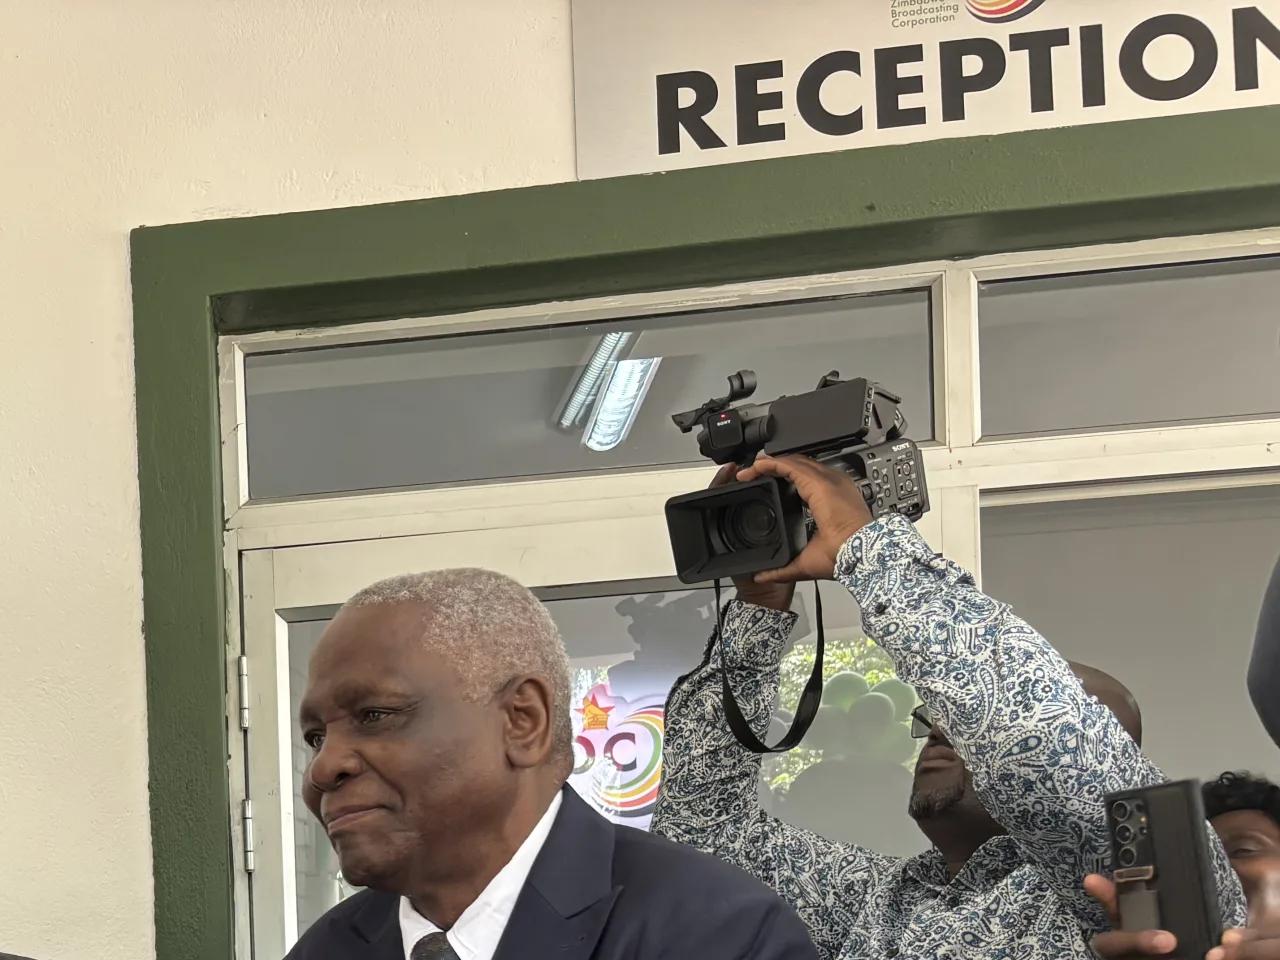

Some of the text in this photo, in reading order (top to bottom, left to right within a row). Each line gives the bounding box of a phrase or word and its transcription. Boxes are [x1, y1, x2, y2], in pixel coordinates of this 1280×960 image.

[891, 3, 959, 18] Broadcasting
[891, 14, 955, 28] Corporation
[891, 442, 910, 452] SONY
